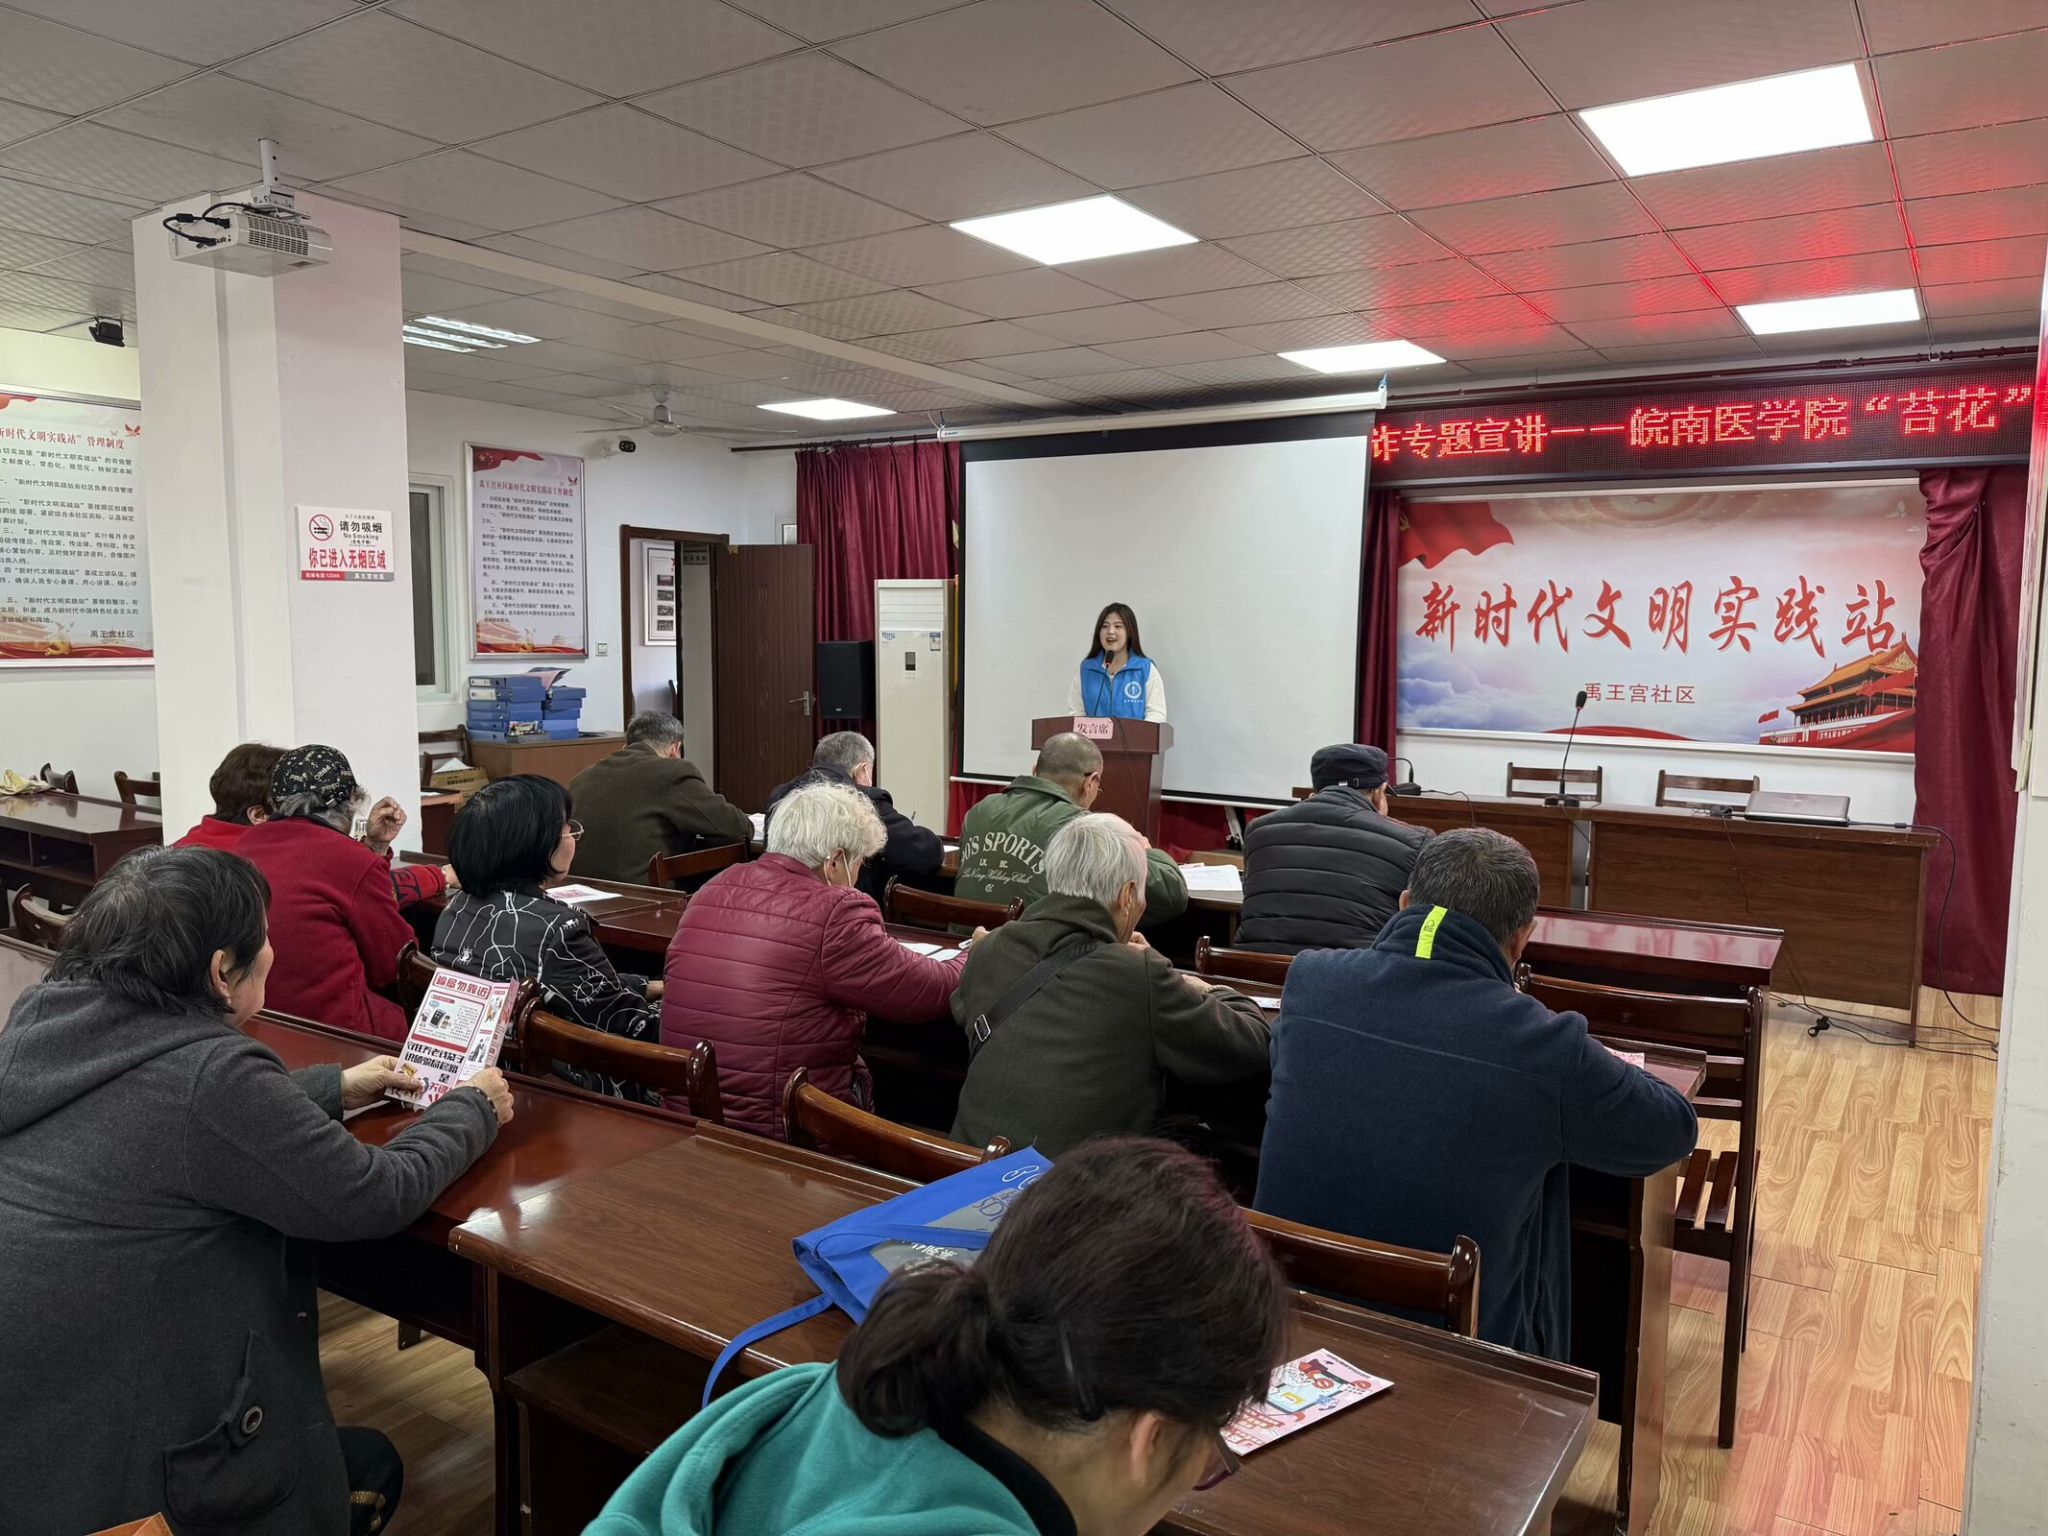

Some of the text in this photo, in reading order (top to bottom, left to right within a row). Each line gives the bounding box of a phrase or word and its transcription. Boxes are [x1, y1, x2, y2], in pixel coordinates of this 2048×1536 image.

[339, 520, 383, 533] 请勿吸烟
[353, 533, 379, 541] Smoking
[308, 547, 387, 570] 你已进入无烟区域
[1415, 575, 1898, 659] 新时代文明实践站
[1584, 683, 1696, 705] 禹王宫社区
[983, 831, 1045, 875] SPORTS
[436, 975, 489, 997] 骗局勿靠近
